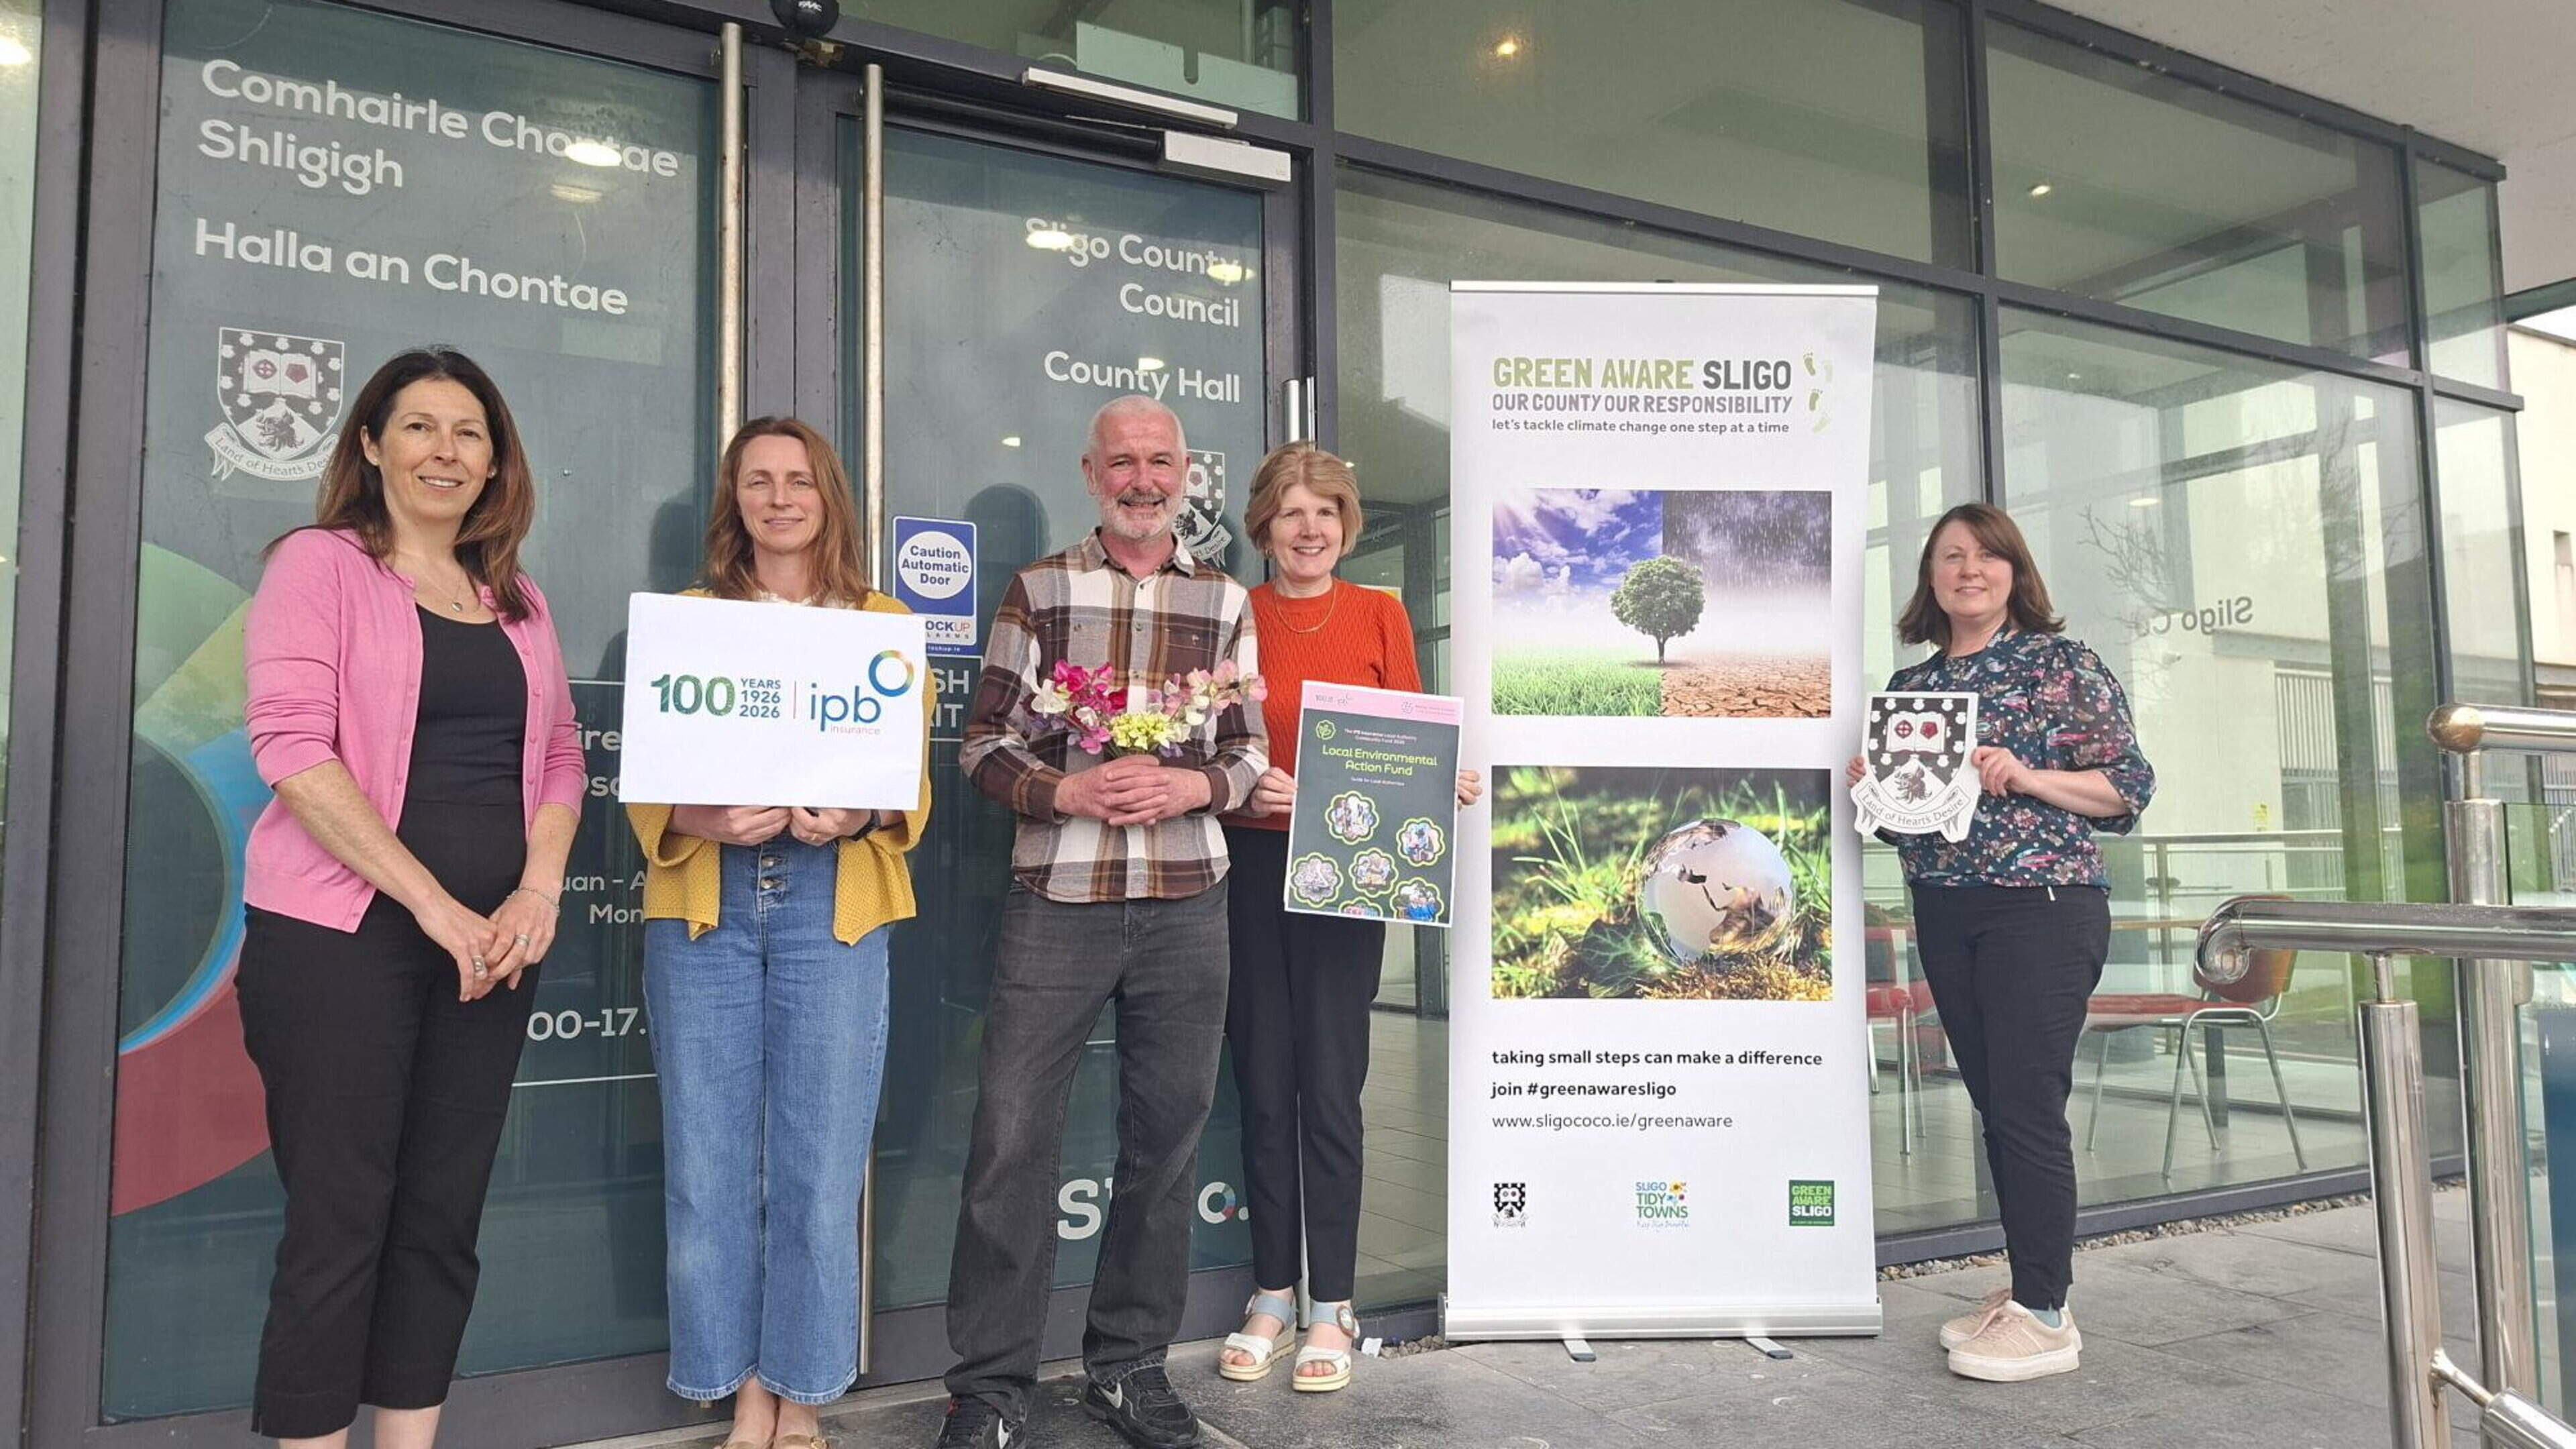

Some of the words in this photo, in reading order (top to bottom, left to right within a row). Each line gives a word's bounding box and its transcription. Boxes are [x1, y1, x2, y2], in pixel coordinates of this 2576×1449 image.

[202, 59, 469, 140] Comhairle
[482, 111, 678, 177] Chotae
[199, 119, 402, 195] Shligigh
[196, 218, 332, 273] Halla
[345, 251, 409, 284] an
[424, 254, 628, 315] Chontae
[1120, 283, 1239, 327] Council
[1044, 351, 1169, 400] County
[1179, 368, 1240, 403] Hall
[1493, 358, 1593, 388] GREEN
[1601, 359, 1694, 389] AWARE
[1703, 360, 1792, 390] SLIGO
[1493, 393, 1529, 411] OUR
[1532, 394, 1601, 412] COUNTY
[1604, 395, 1640, 413] OUR
[1644, 395, 1792, 414] RESPONSIBILITY
[1492, 419, 1520, 430] let's
[1523, 419, 1564, 431] tackle
[1567, 421, 1616, 431] climate
[1619, 421, 1666, 435] change
[1670, 424, 1695, 433] one
[1698, 423, 1727, 435] step
[1730, 423, 1743, 433] at
[1747, 425, 1755, 433] a
[1758, 422, 1789, 433] time
[215, 436, 244, 464] Land
[910, 545, 961, 559] Caution
[902, 559, 969, 574] Automatic
[920, 574, 950, 585] Door
[925, 621, 971, 632] OCKUP
[651, 674, 735, 716] 100
[741, 678, 782, 690] YEARS
[810, 683, 881, 732] ipb
[741, 690, 781, 704] 1926
[739, 705, 780, 718] 2026
[931, 703, 963, 728] IT
[830, 724, 881, 735] insurance
[1322, 745, 1353, 757] Local
[1354, 748, 1438, 766] Environmental
[1345, 759, 1382, 773] Action
[1384, 763, 1413, 775] Fund
[1862, 794, 1882, 816] Land
[1933, 798, 1964, 820] Desire
[1492, 1051, 1544, 1067] taking
[1548, 1050, 1591, 1064] small
[1595, 1051, 1641, 1067] steps
[1644, 1053, 1673, 1064] can
[1676, 1051, 1721, 1064] make
[1725, 1054, 1734, 1064] a
[1738, 1051, 1823, 1065] difference
[1490, 1082, 1523, 1099] join
[1527, 1081, 1676, 1099] #greenawaresligo
[1492, 1114, 1733, 1131] www.sligococo.ie/greenaware
[1635, 1181, 1667, 1191] SLIGO
[1792, 1185, 1832, 1195] GREEN
[1635, 1192, 1666, 1205] TIDY
[1792, 1196, 1831, 1205] AWARE
[1635, 1205, 1688, 1218] TOWNS
[1792, 1205, 1832, 1217] SLIGO
